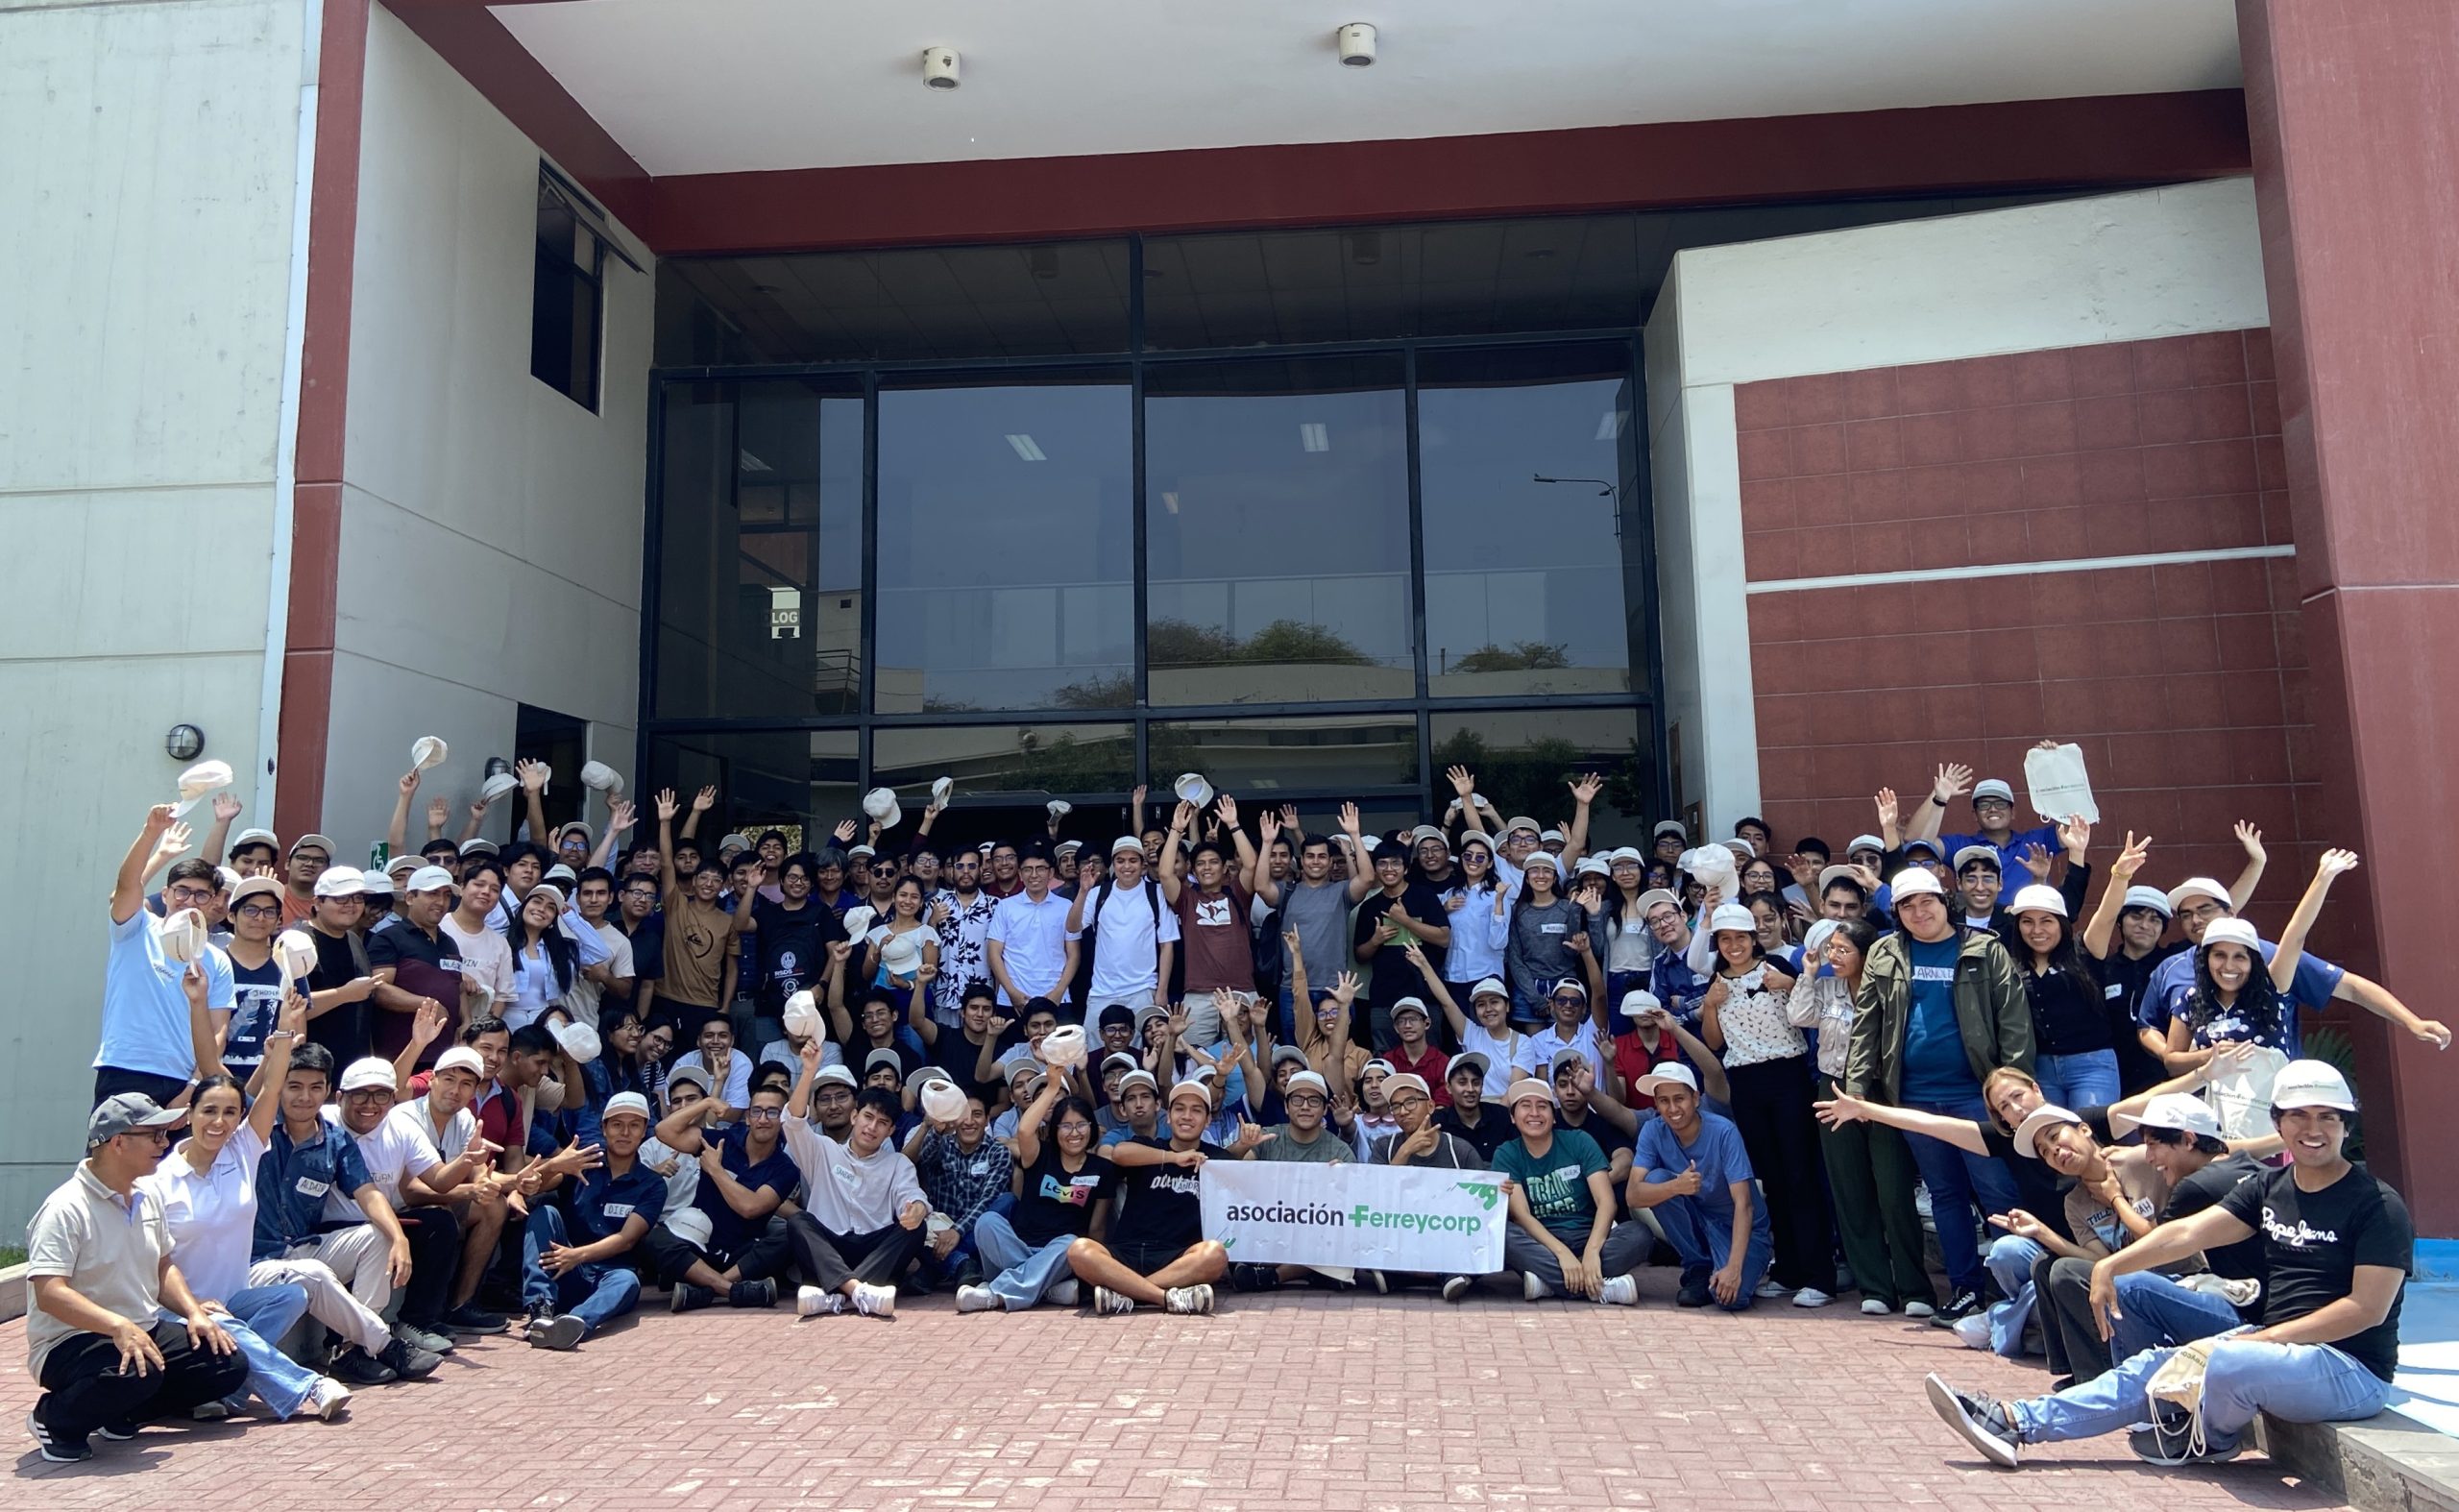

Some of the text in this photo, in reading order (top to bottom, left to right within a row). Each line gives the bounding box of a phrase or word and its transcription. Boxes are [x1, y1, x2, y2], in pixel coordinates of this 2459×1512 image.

[608, 1205, 631, 1216] DIEG
[1227, 1200, 1481, 1236] asociación Ferreycorp
[2262, 1207, 2337, 1246] Pepe Jeans
